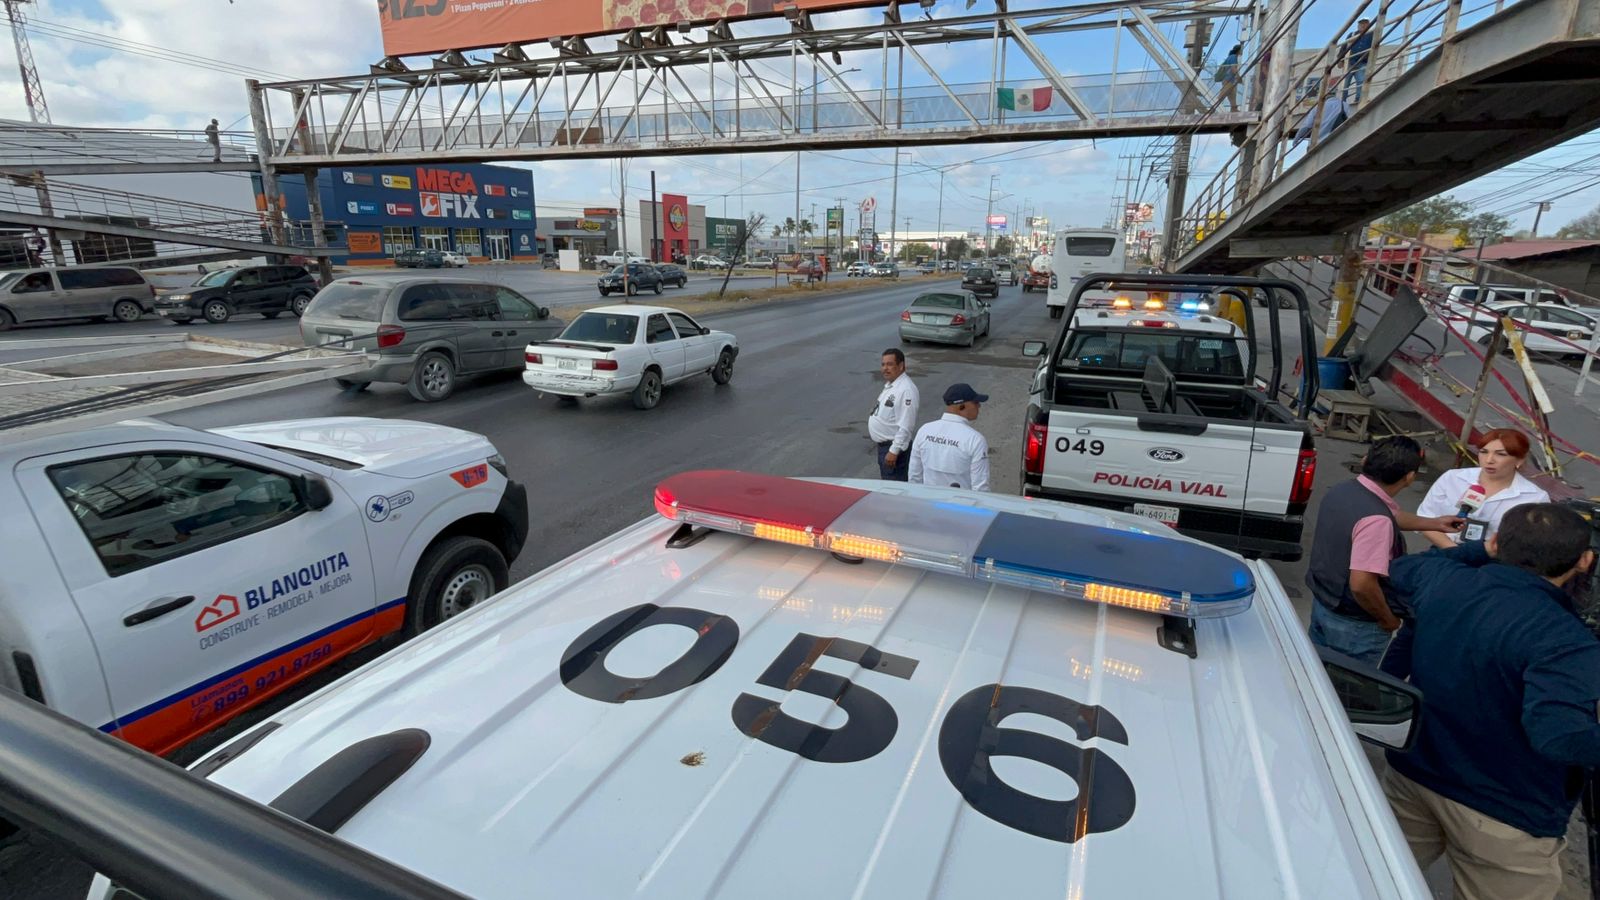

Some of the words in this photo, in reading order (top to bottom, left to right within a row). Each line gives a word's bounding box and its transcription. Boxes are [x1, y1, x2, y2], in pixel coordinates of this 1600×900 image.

[472, 0, 504, 12] Pepperoni
[416, 167, 478, 195] MEGA
[440, 193, 481, 219] FIX
[1055, 436, 1105, 456] 049
[1152, 449, 1180, 461] Ford
[1093, 472, 1173, 493] POLICÍA
[1179, 482, 1229, 498] VIAL
[245, 551, 350, 610] BLANQUITA
[199, 615, 260, 650] CONSTRUYE
[266, 589, 314, 622] REMODELA
[319, 573, 353, 597] MEJORA
[255, 665, 287, 690] 921
[292, 643, 332, 673] 8750
[559, 602, 1137, 844] 056
